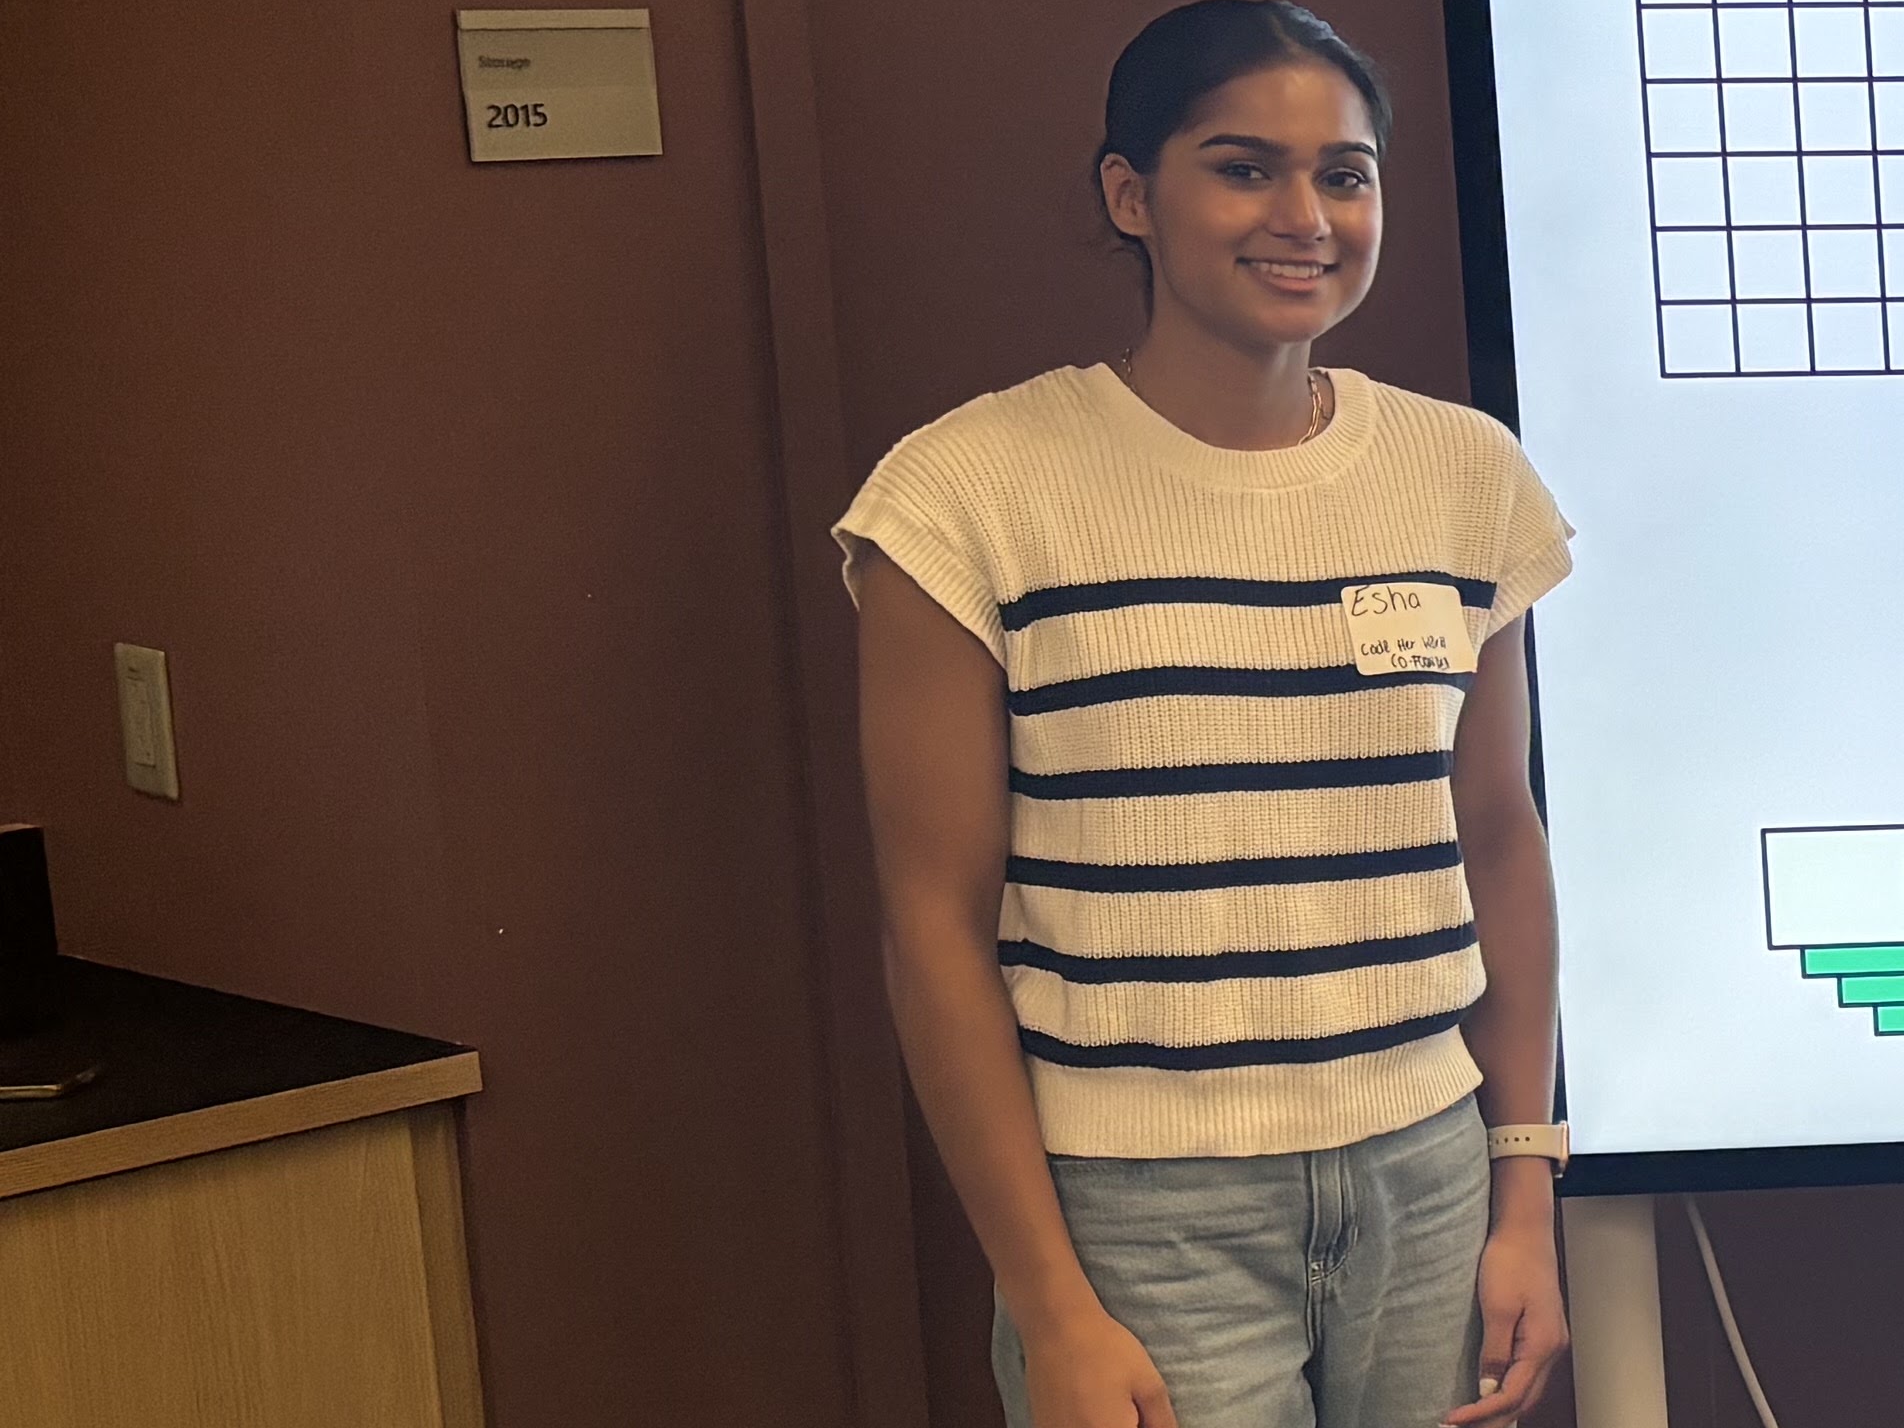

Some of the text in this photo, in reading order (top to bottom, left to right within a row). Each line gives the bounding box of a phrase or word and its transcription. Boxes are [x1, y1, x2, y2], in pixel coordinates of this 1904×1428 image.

[486, 103, 548, 128] 2015
[1351, 585, 1422, 616] Esha
[1361, 639, 1391, 656] Code
